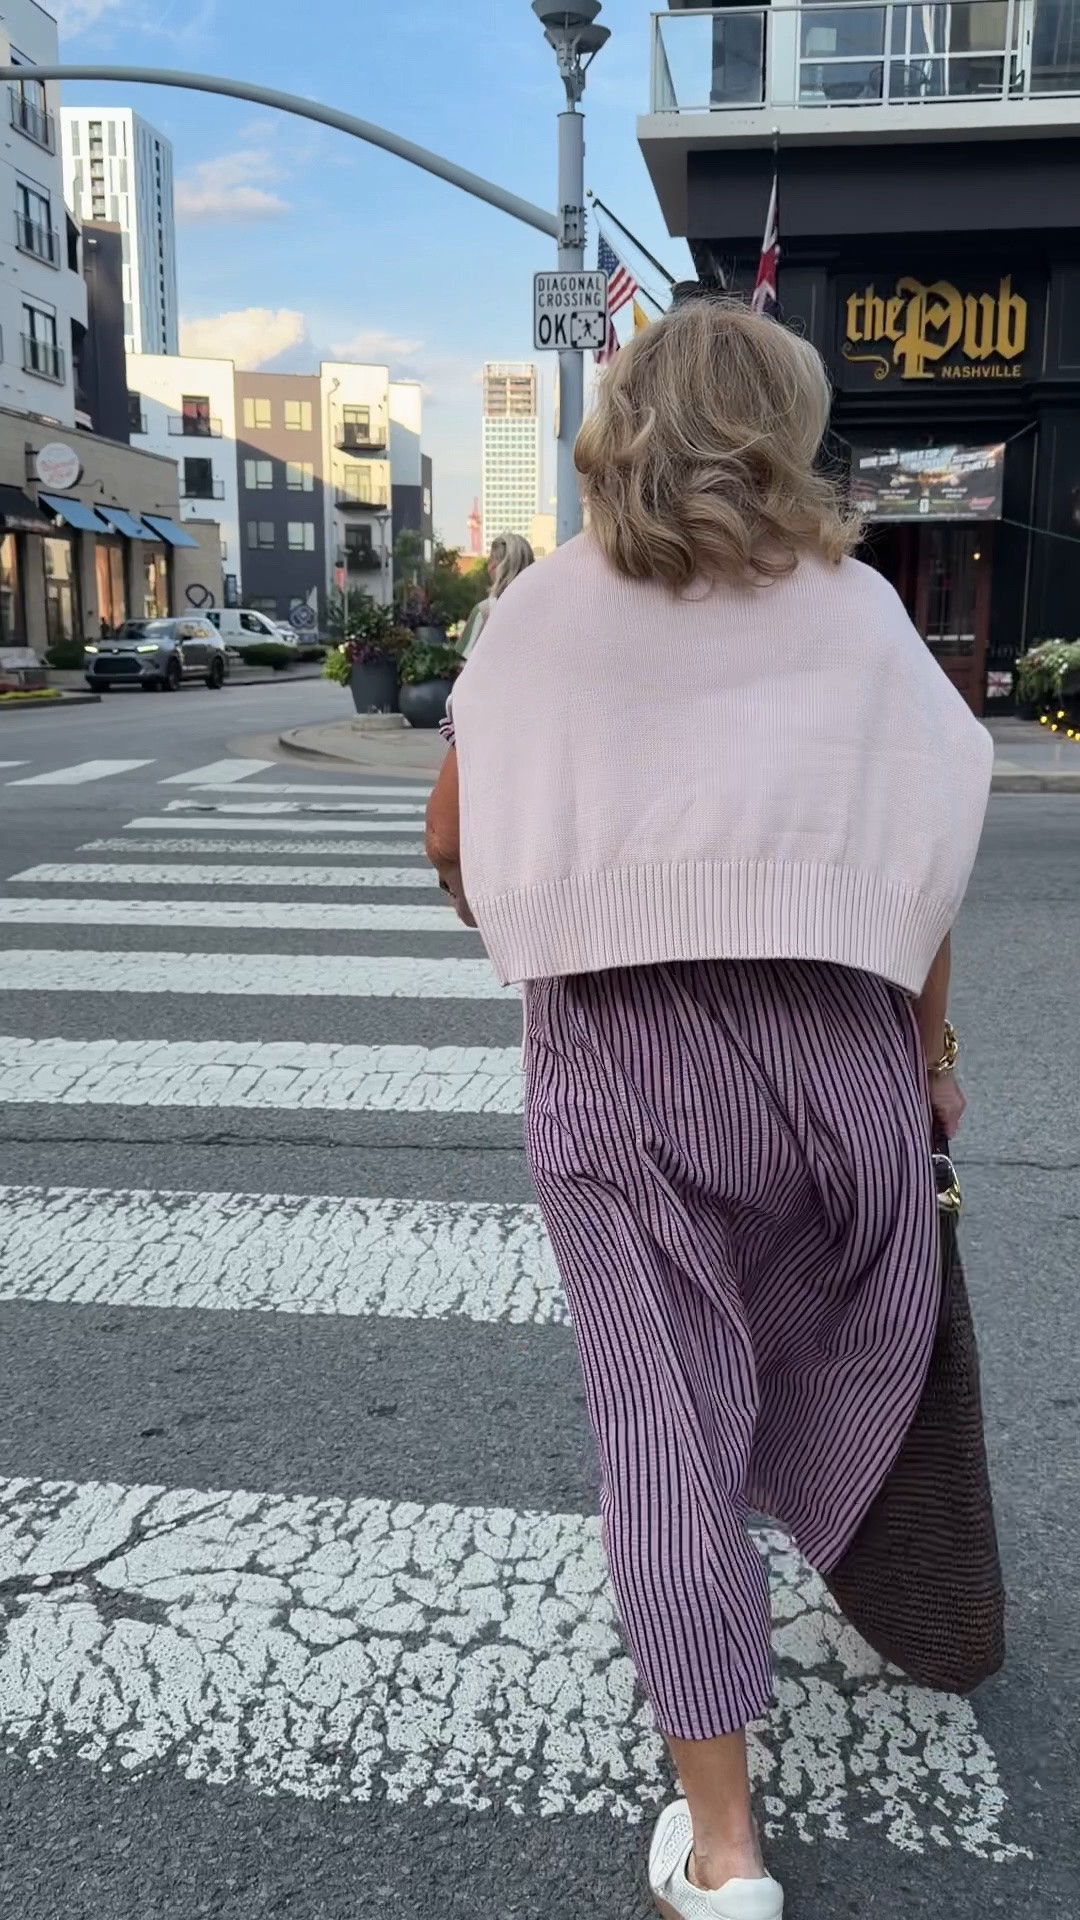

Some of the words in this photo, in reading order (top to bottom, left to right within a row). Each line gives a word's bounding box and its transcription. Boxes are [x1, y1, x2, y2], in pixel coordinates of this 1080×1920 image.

[538, 277, 602, 292] DIAGONAL
[538, 292, 601, 307] CROSSING
[539, 313, 567, 345] OK
[846, 283, 905, 342] the
[893, 273, 1027, 379] Pub
[941, 364, 1021, 378] NASHVILLE
